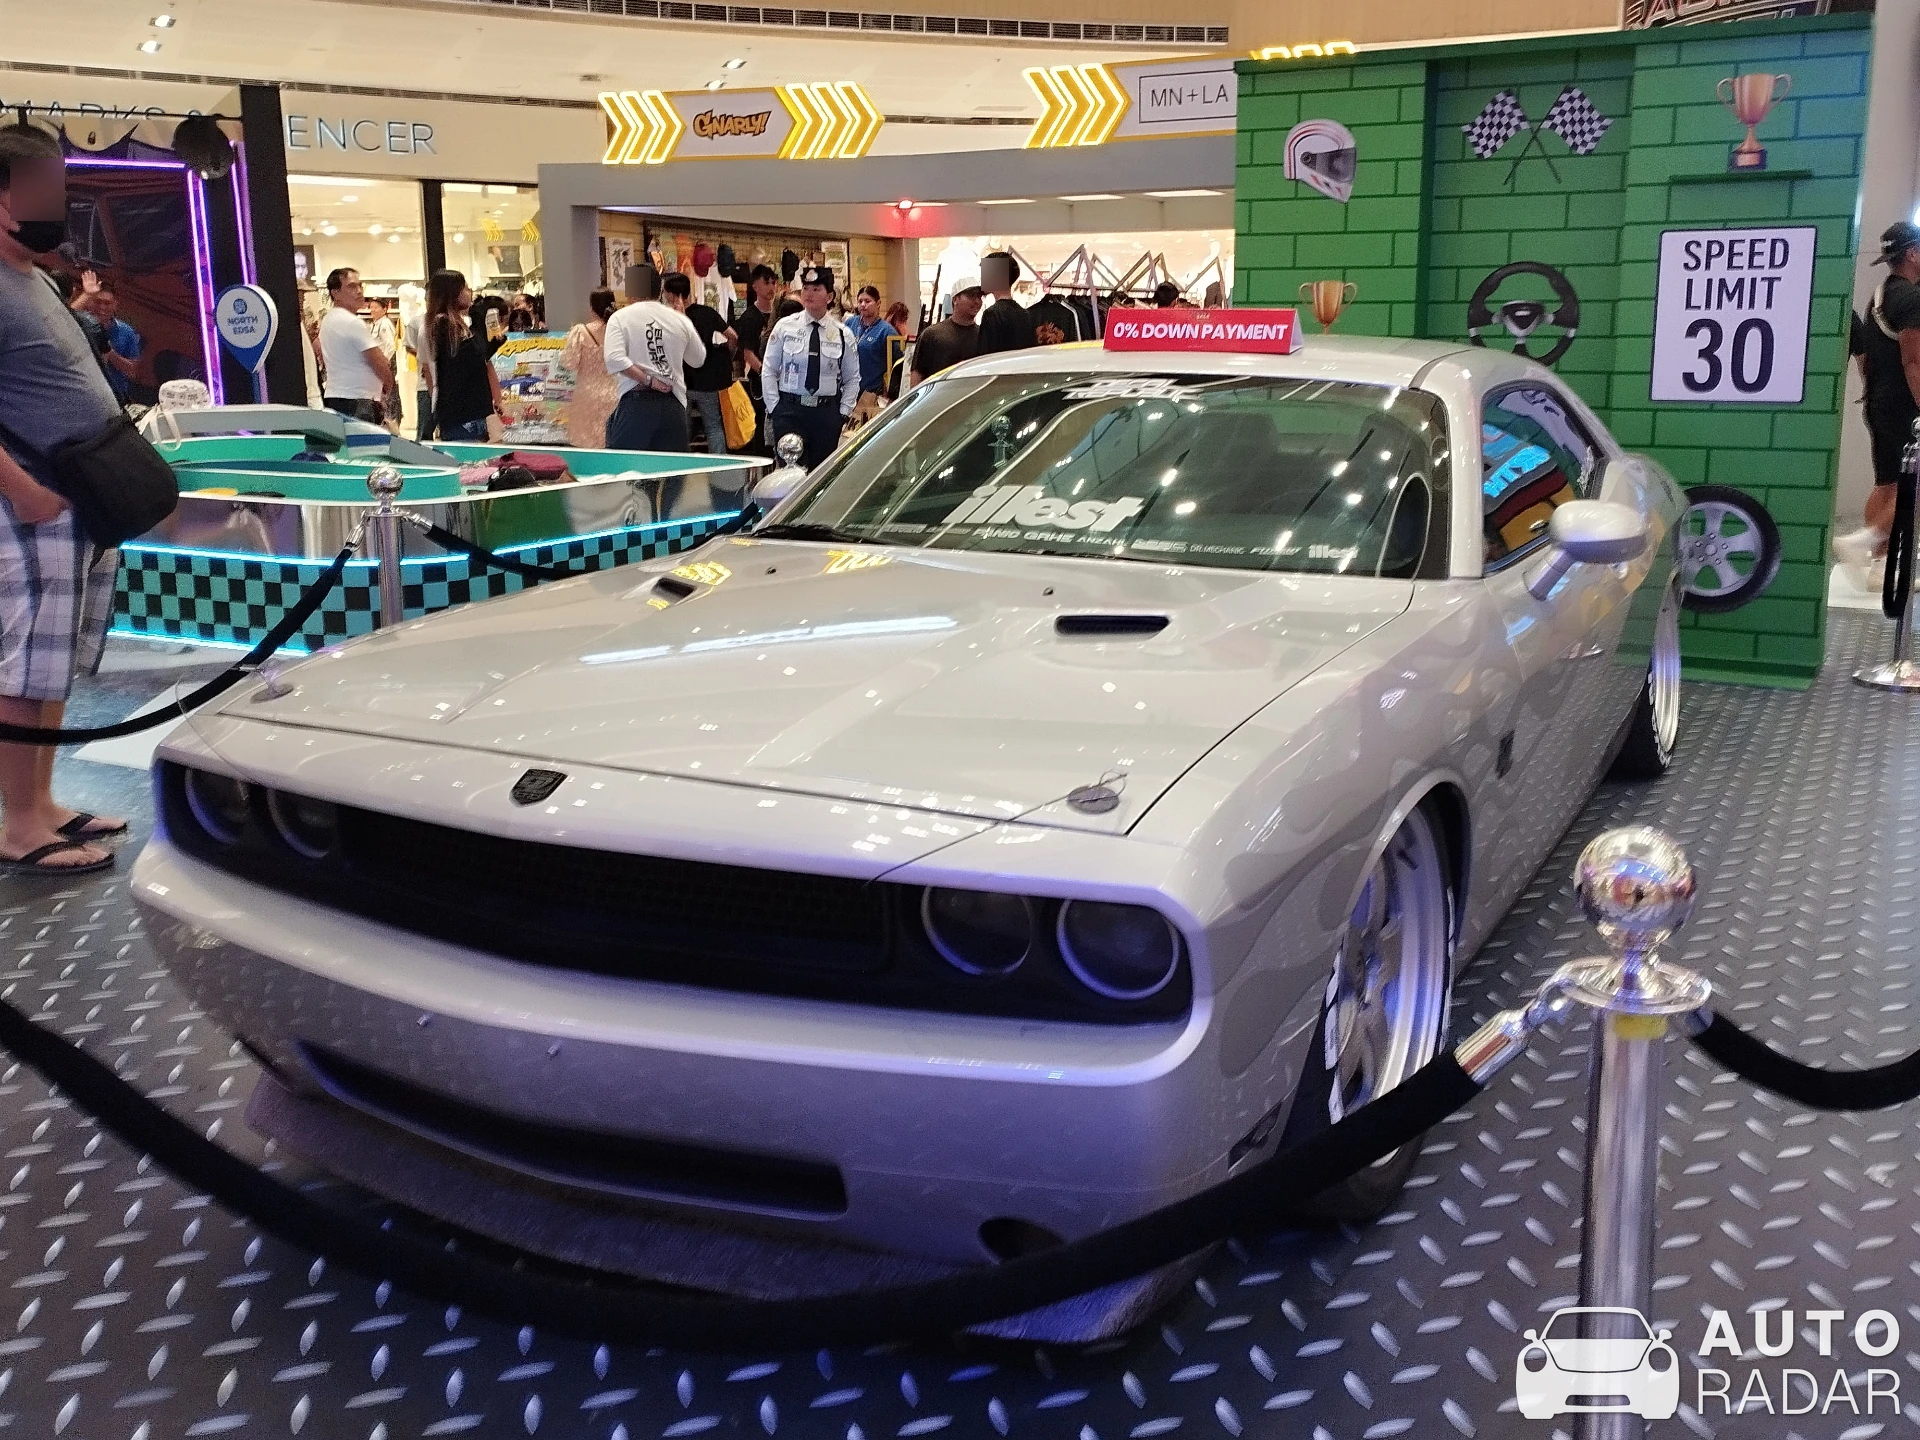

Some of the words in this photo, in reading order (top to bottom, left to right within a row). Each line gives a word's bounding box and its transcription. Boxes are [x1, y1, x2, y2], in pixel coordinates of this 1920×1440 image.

[1150, 83, 1229, 107] MN+LA
[287, 114, 437, 155] ENCER
[693, 108, 772, 140] GNARLY!
[1682, 238, 1790, 272] SPEED
[1684, 276, 1782, 311] LIMIT
[227, 315, 258, 326] NORTH
[233, 326, 256, 335] EDSA
[1113, 322, 1139, 339] 0%
[1141, 323, 1200, 339] DOWN
[1201, 324, 1289, 340] PAYMENT
[1681, 317, 1775, 395] 30
[941, 484, 1145, 533] illest
